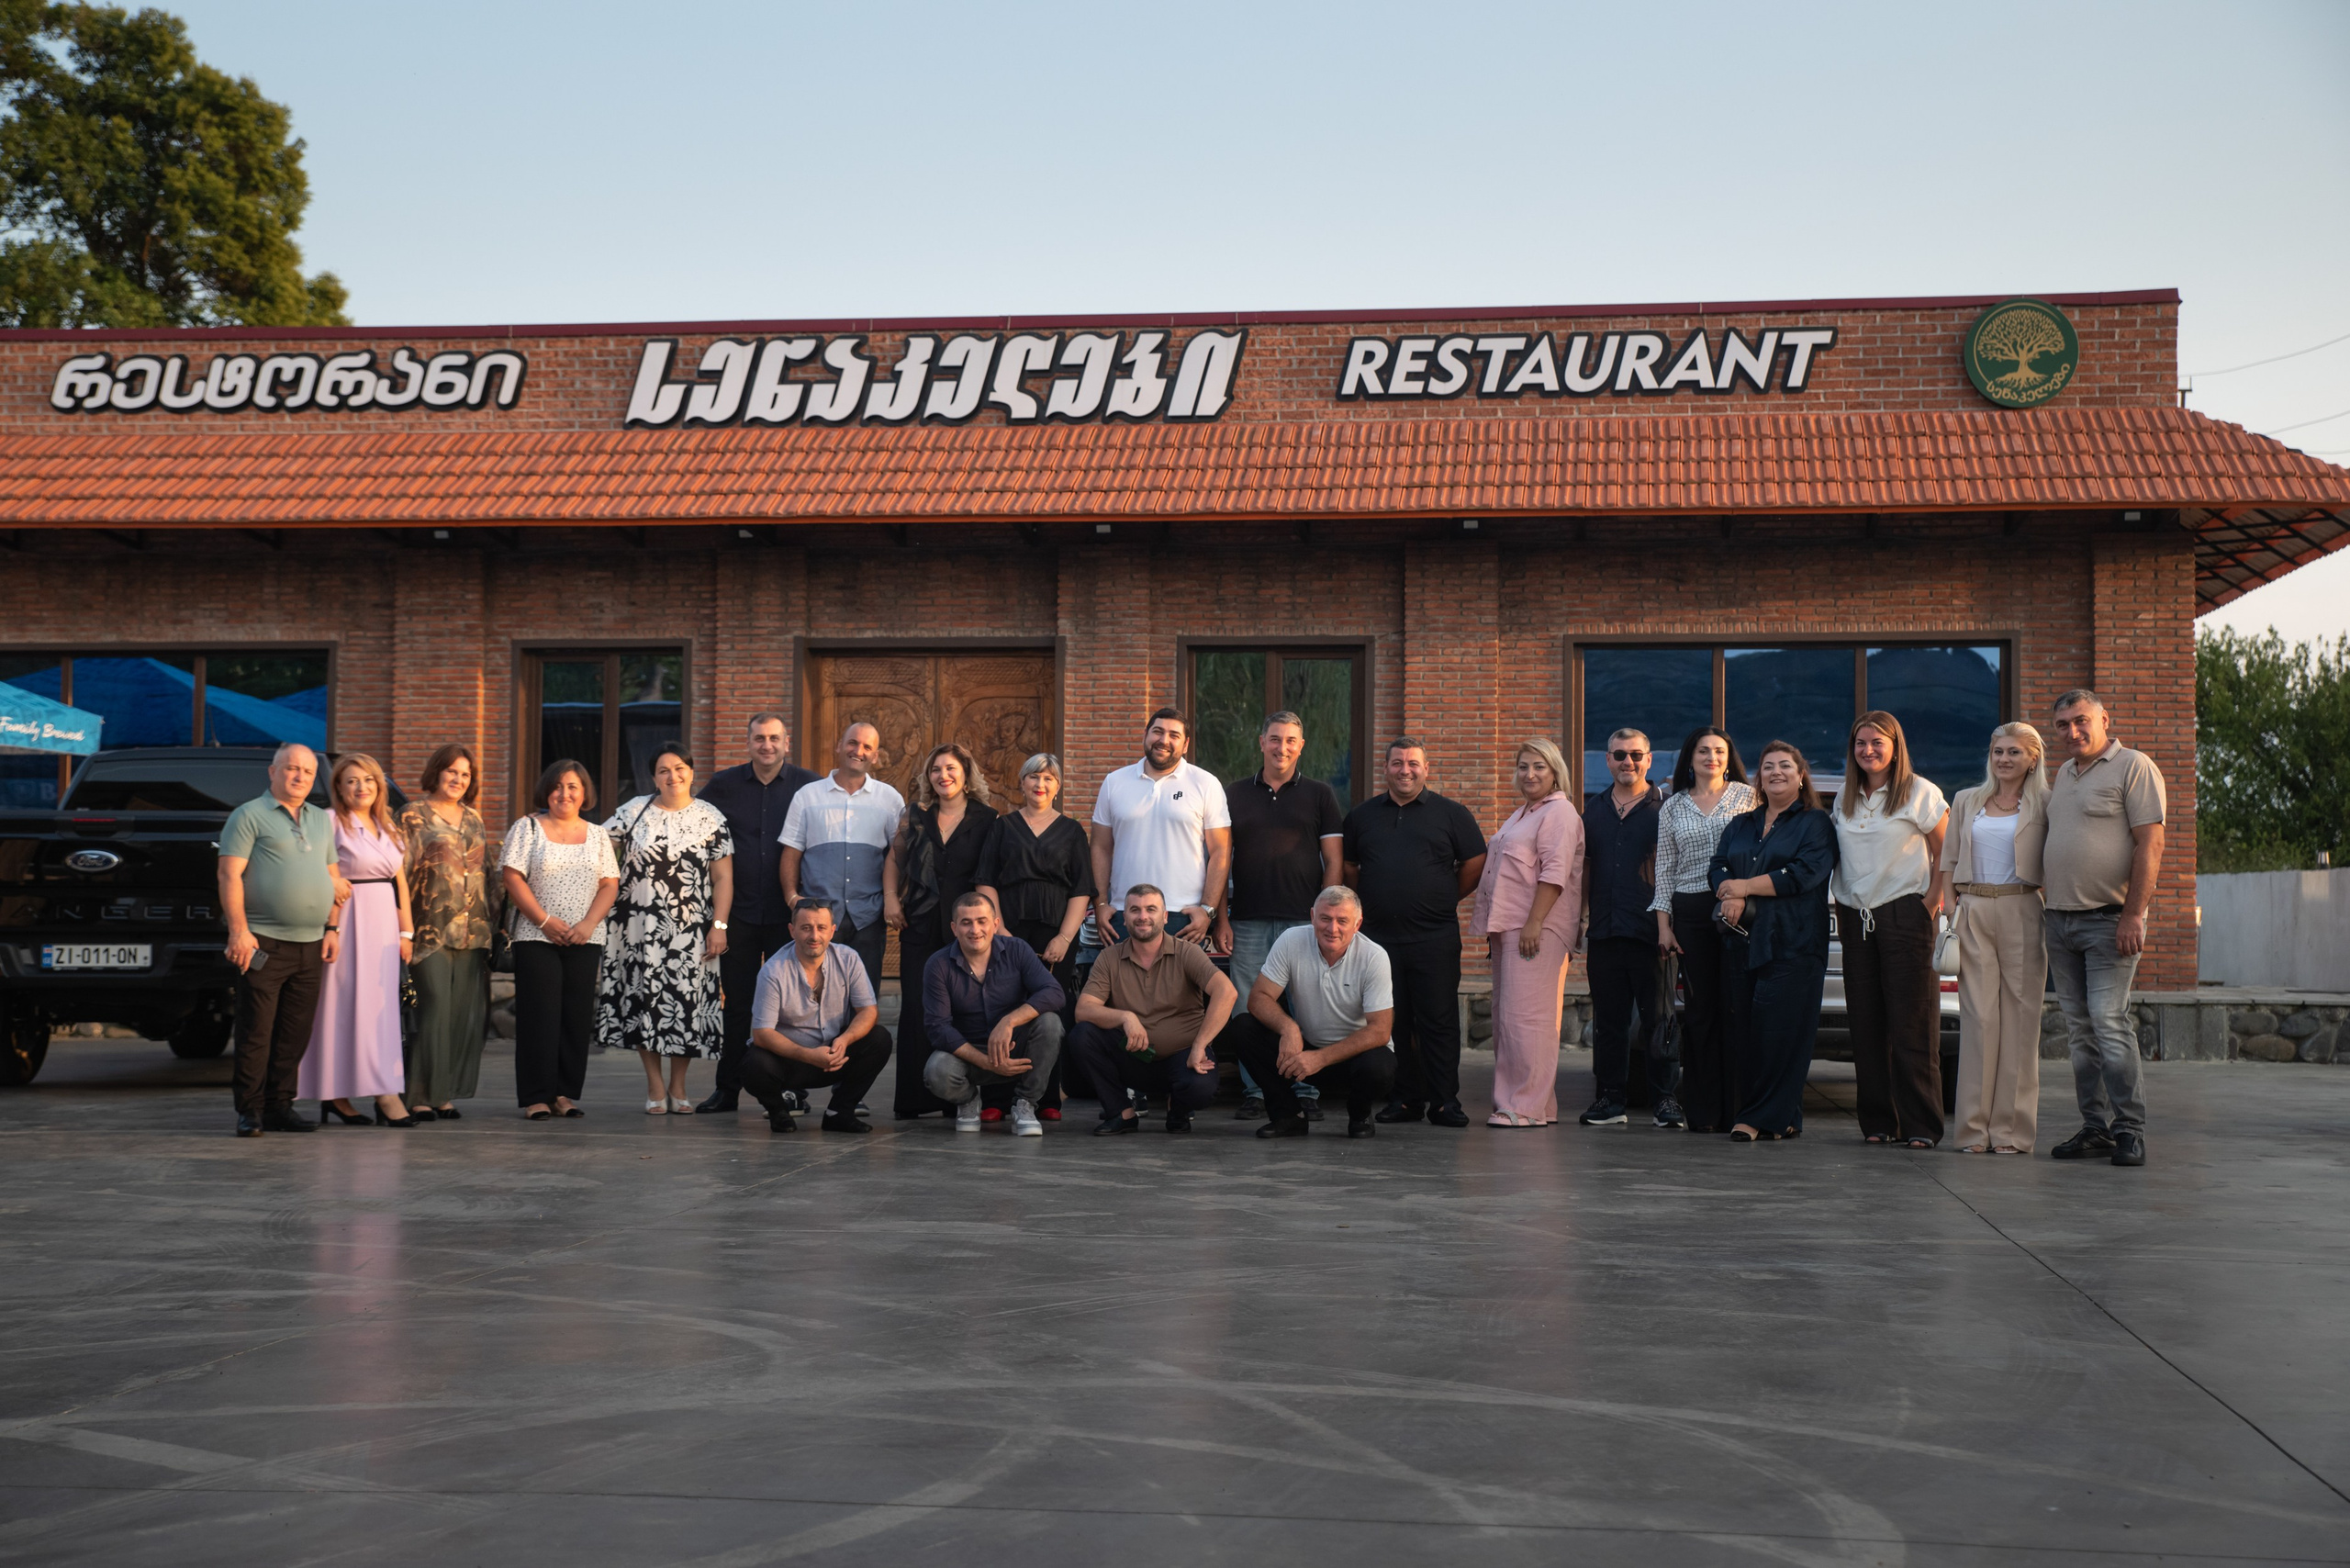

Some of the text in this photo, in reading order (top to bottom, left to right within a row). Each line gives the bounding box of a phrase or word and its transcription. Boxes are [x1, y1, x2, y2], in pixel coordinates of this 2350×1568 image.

[50, 349, 523, 409] რესტორანი
[626, 330, 1243, 426] სენაკელები
[1340, 330, 1834, 396] RESTAURANT
[1986, 364, 2071, 403] სენაკელები
[0, 717, 39, 742] Family
[77, 854, 107, 867] Ford
